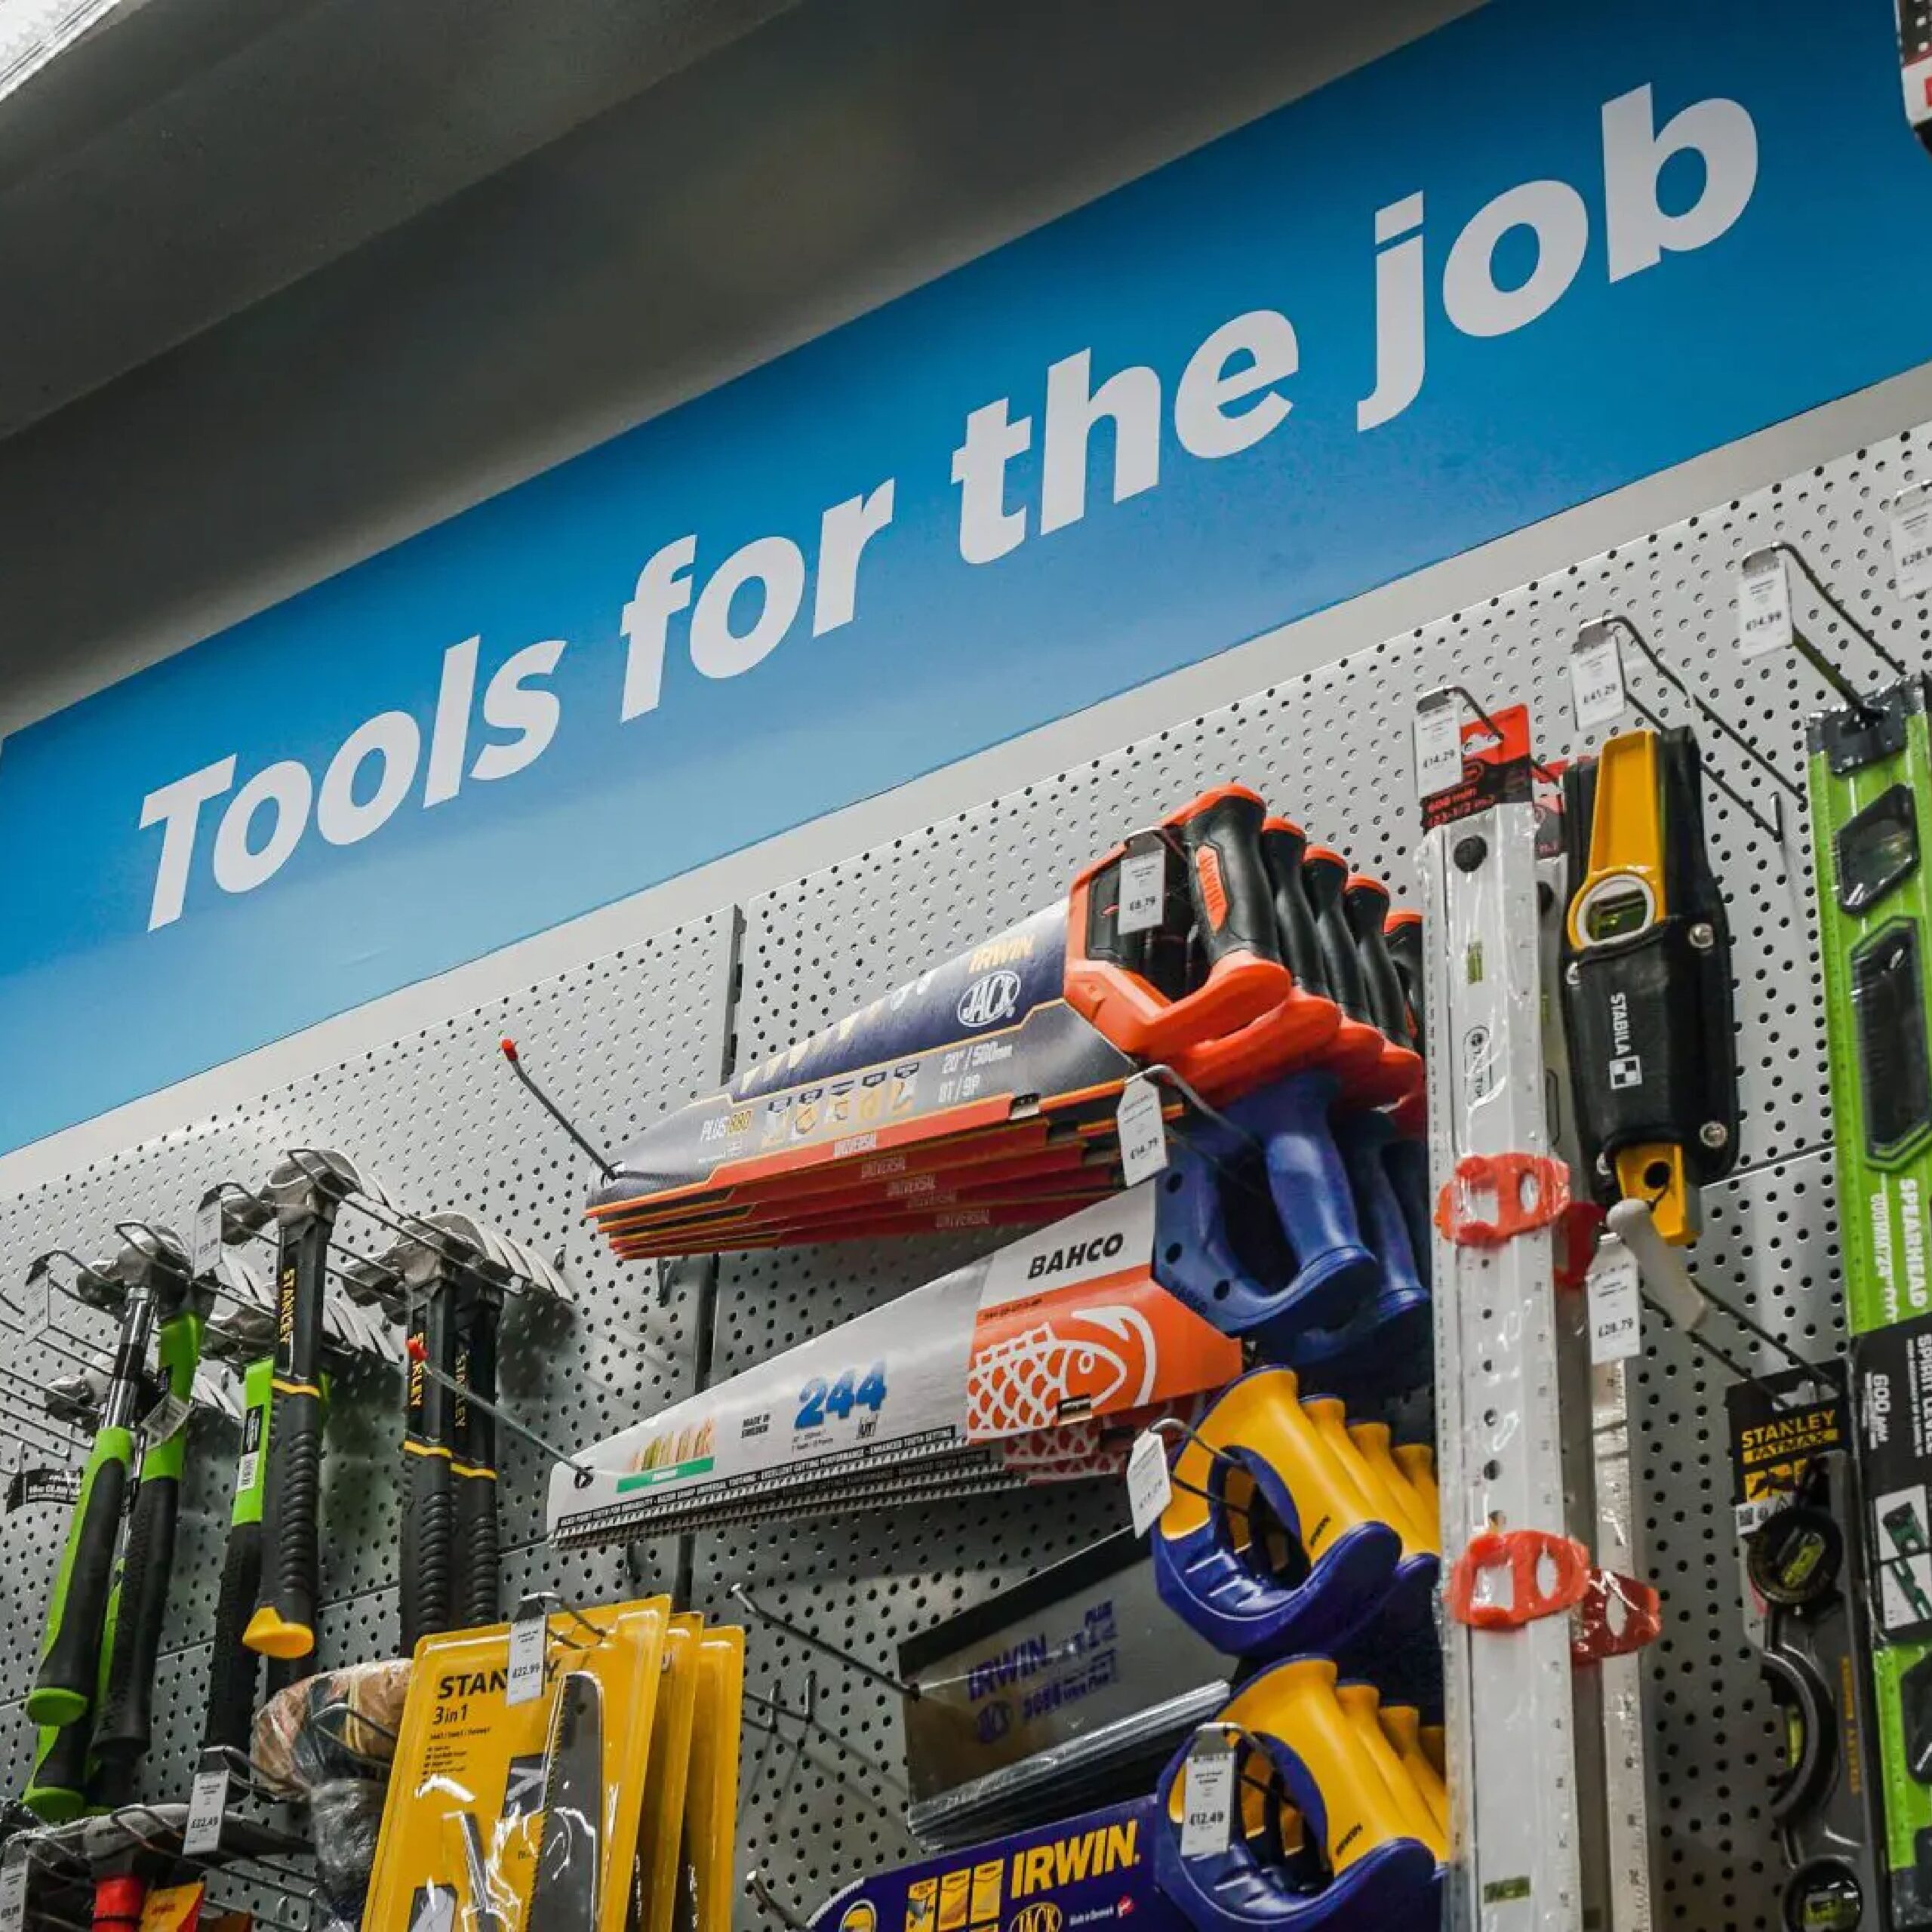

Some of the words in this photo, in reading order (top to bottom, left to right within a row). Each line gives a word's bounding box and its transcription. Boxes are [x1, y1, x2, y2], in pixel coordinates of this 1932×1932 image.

[138, 634, 568, 933] Tools
[620, 478, 895, 722] for
[951, 309, 1299, 564] the
[1358, 82, 1758, 432] job
[1423, 749, 1455, 768] £14.29
[1129, 896, 1156, 912] £8.79
[969, 934, 1036, 974] IRWIN
[1610, 992, 1632, 1057] STABILA
[1027, 1232, 1124, 1281] BAHCO
[1899, 1178, 1927, 1308] SPEARHEAD
[280, 1267, 295, 1344] STANLEY
[1598, 1318, 1634, 1339] £28.79
[795, 1360, 888, 1430] 244
[1873, 1374, 1890, 1412] 600
[1741, 1409, 1835, 1448] STANLEY
[438, 1659, 561, 1700] STANY
[968, 1632, 1047, 1703] IRWIN
[190, 1816, 219, 1829] £22.49
[1189, 1810, 1225, 1827] £12.49
[1010, 1819, 1139, 1900] IRWIN
